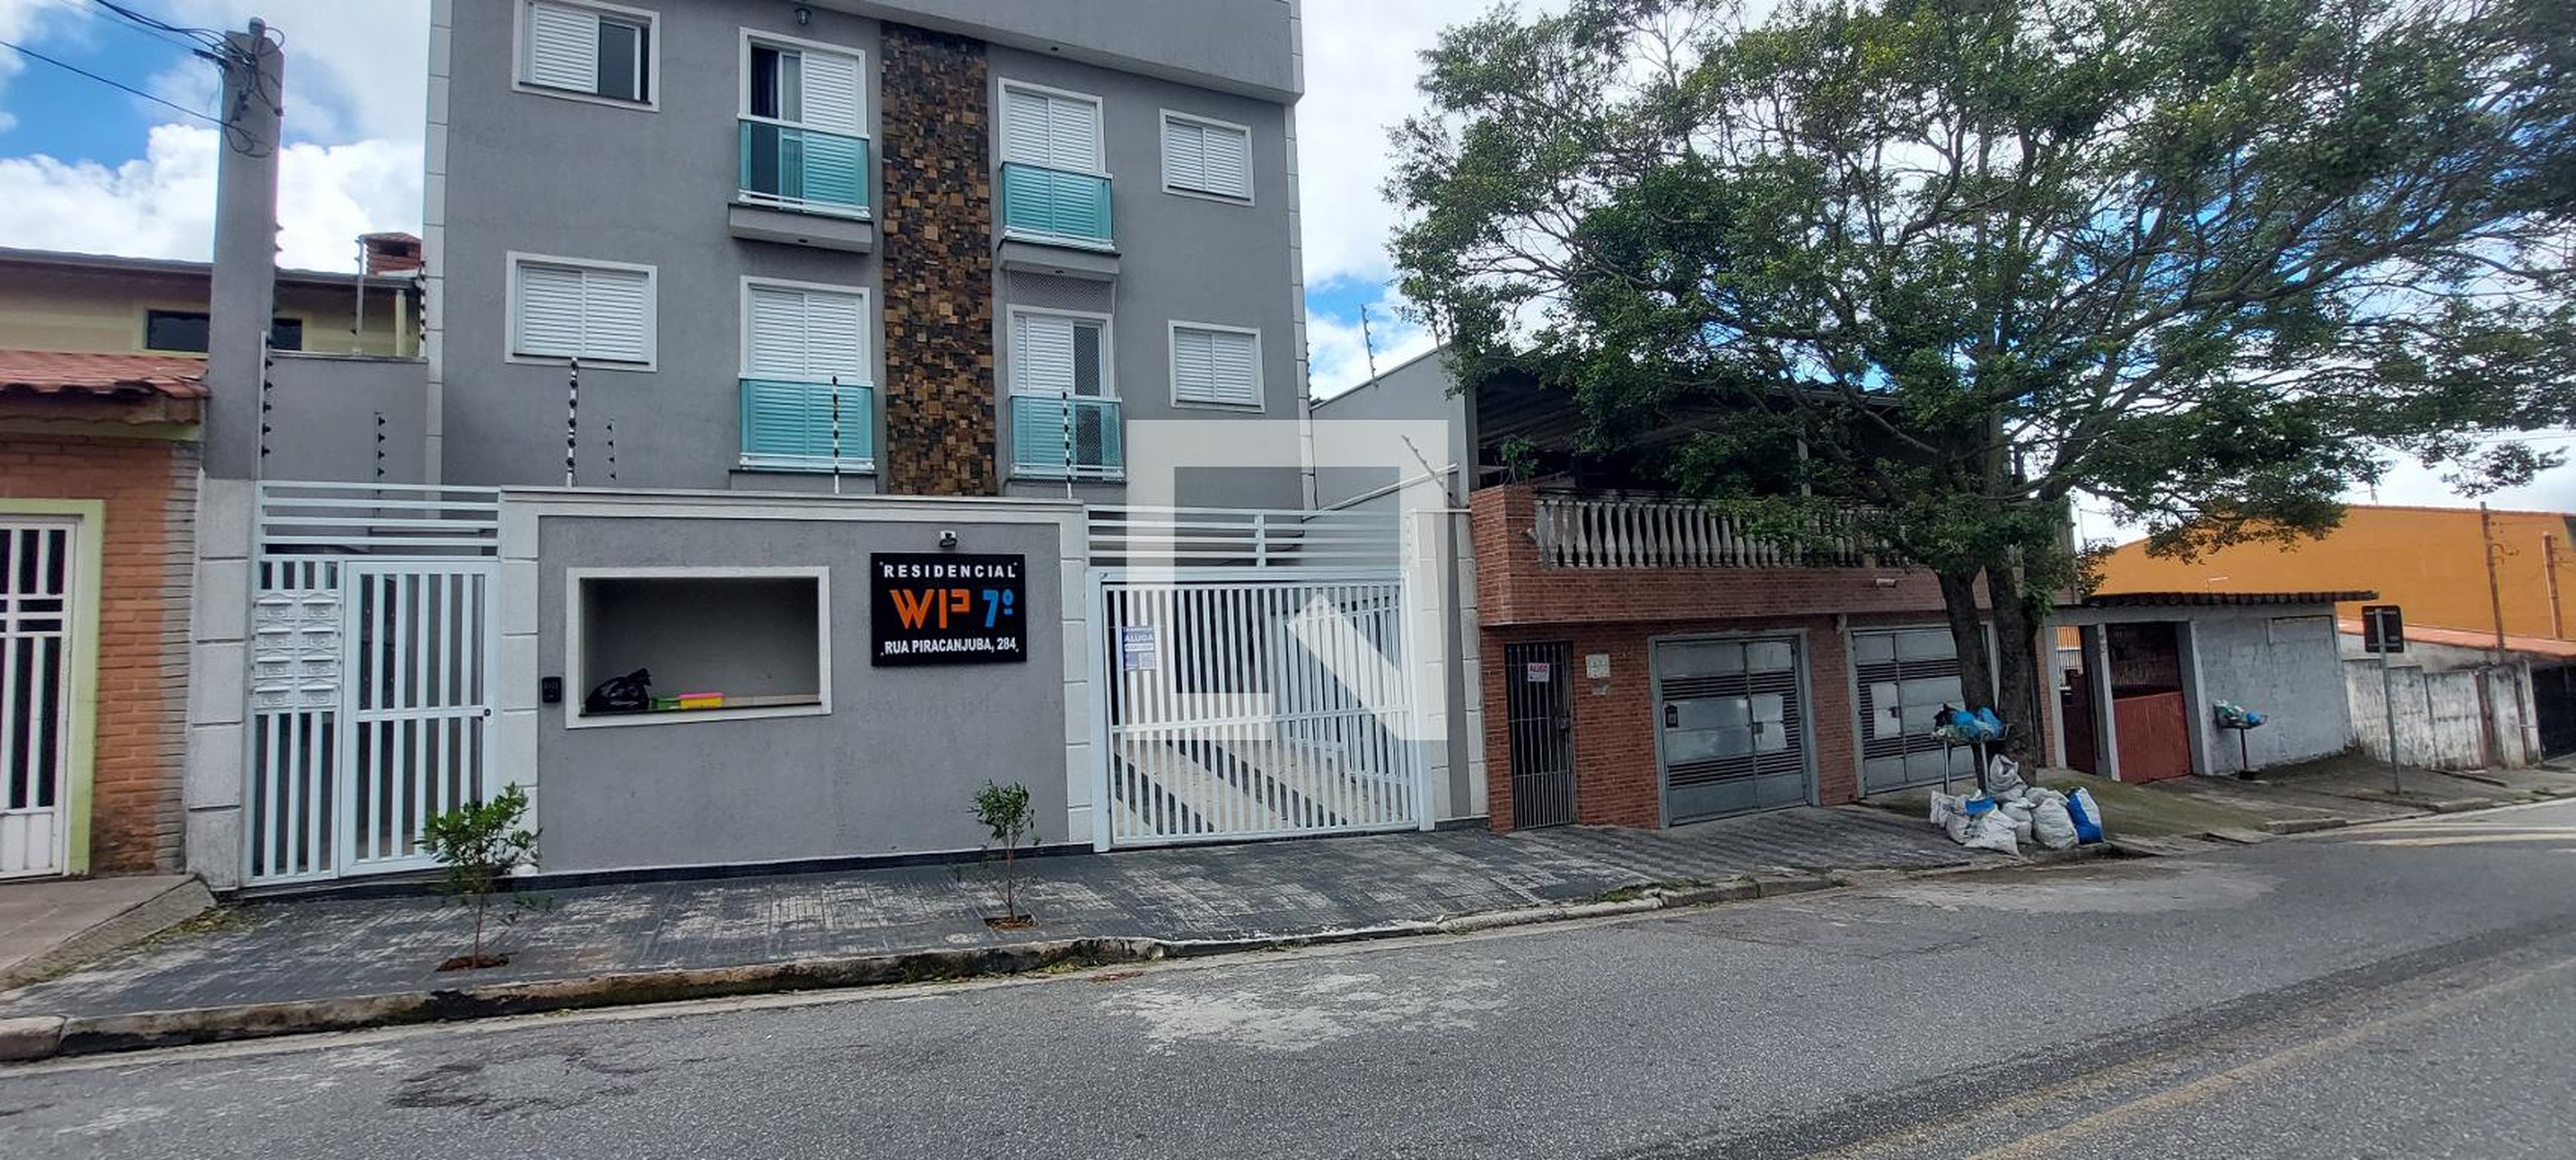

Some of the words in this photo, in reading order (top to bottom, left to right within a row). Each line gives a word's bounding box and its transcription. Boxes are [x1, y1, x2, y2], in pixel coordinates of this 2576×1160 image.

[883, 565, 1016, 578] RESIDENCIAL
[885, 640, 909, 654] RUA
[912, 638, 994, 653] PIRACANJUBA,
[997, 637, 1016, 650] 284
